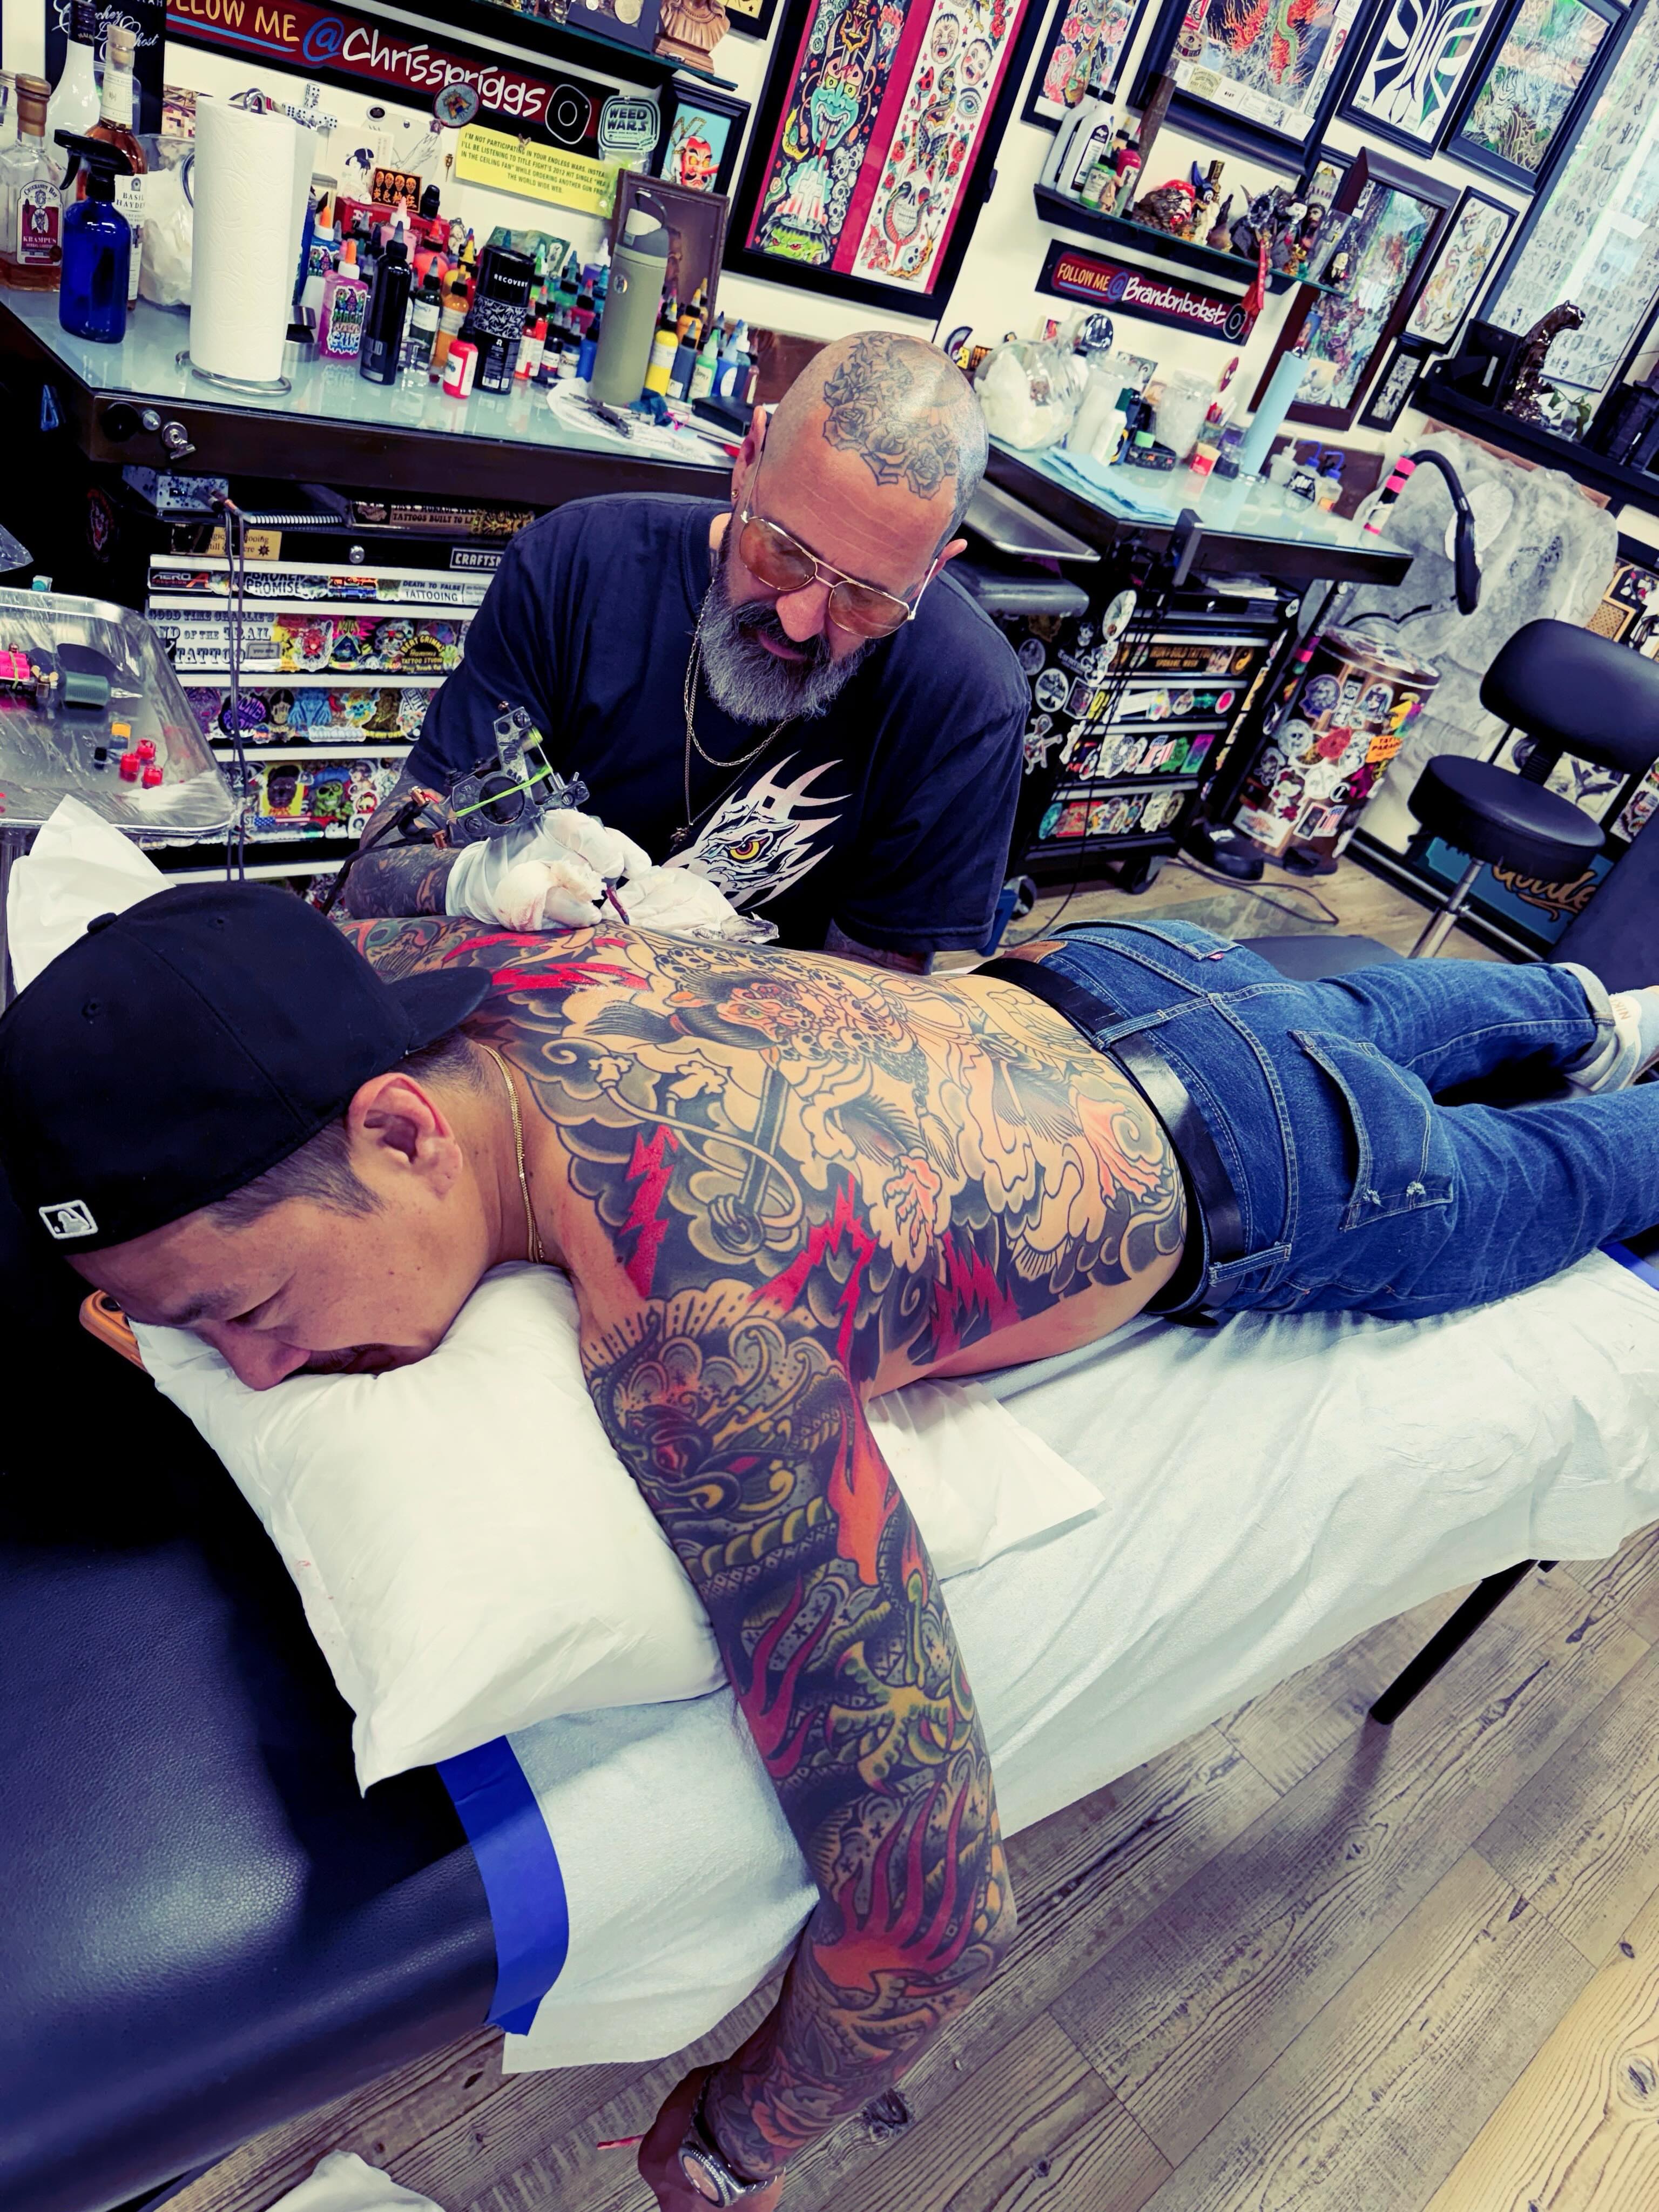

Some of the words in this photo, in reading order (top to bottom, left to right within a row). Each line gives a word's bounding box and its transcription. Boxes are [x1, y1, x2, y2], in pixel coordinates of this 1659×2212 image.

[255, 6, 300, 42] ME
[610, 108, 648, 119] WEED
[608, 120, 649, 131] WARS
[475, 135, 485, 143] NOT
[487, 138, 525, 154] PARTICIPATING
[534, 152, 547, 161] YOUR
[548, 157, 570, 167] ENDLESS
[461, 141, 471, 149] I'LL
[481, 146, 508, 160] LISTENING
[517, 157, 531, 166] TITLE
[532, 161, 552, 172] FIGHT'S
[553, 167, 565, 175] 2012
[576, 174, 592, 183] SINGLE
[469, 152, 478, 160] THE
[480, 156, 500, 167] CEILING
[516, 166, 531, 175] WHILE
[532, 171, 557, 183] ORDERING
[559, 178, 582, 188] ANOTHER
[508, 172, 517, 181] THE
[518, 176, 536, 186] WORLD
[537, 181, 550, 191] WIDE
[23, 235, 57, 244] KRAMPUS
[494, 273, 529, 287] RECOVERY
[1057, 263, 1094, 288] FOLLOW
[1094, 274, 1110, 292] ME
[392, 512, 427, 522] TATTOOS
[431, 514, 451, 523] BUILT
[454, 515, 463, 523] TO
[152, 571, 191, 580] AERO
[402, 580, 425, 589] DEATH
[440, 583, 461, 591] FALSE
[405, 590, 458, 602] TATTOOING
[148, 610, 181, 621] GOOD
[184, 610, 212, 622] TIME
[175, 648, 246, 664] TATTOO
